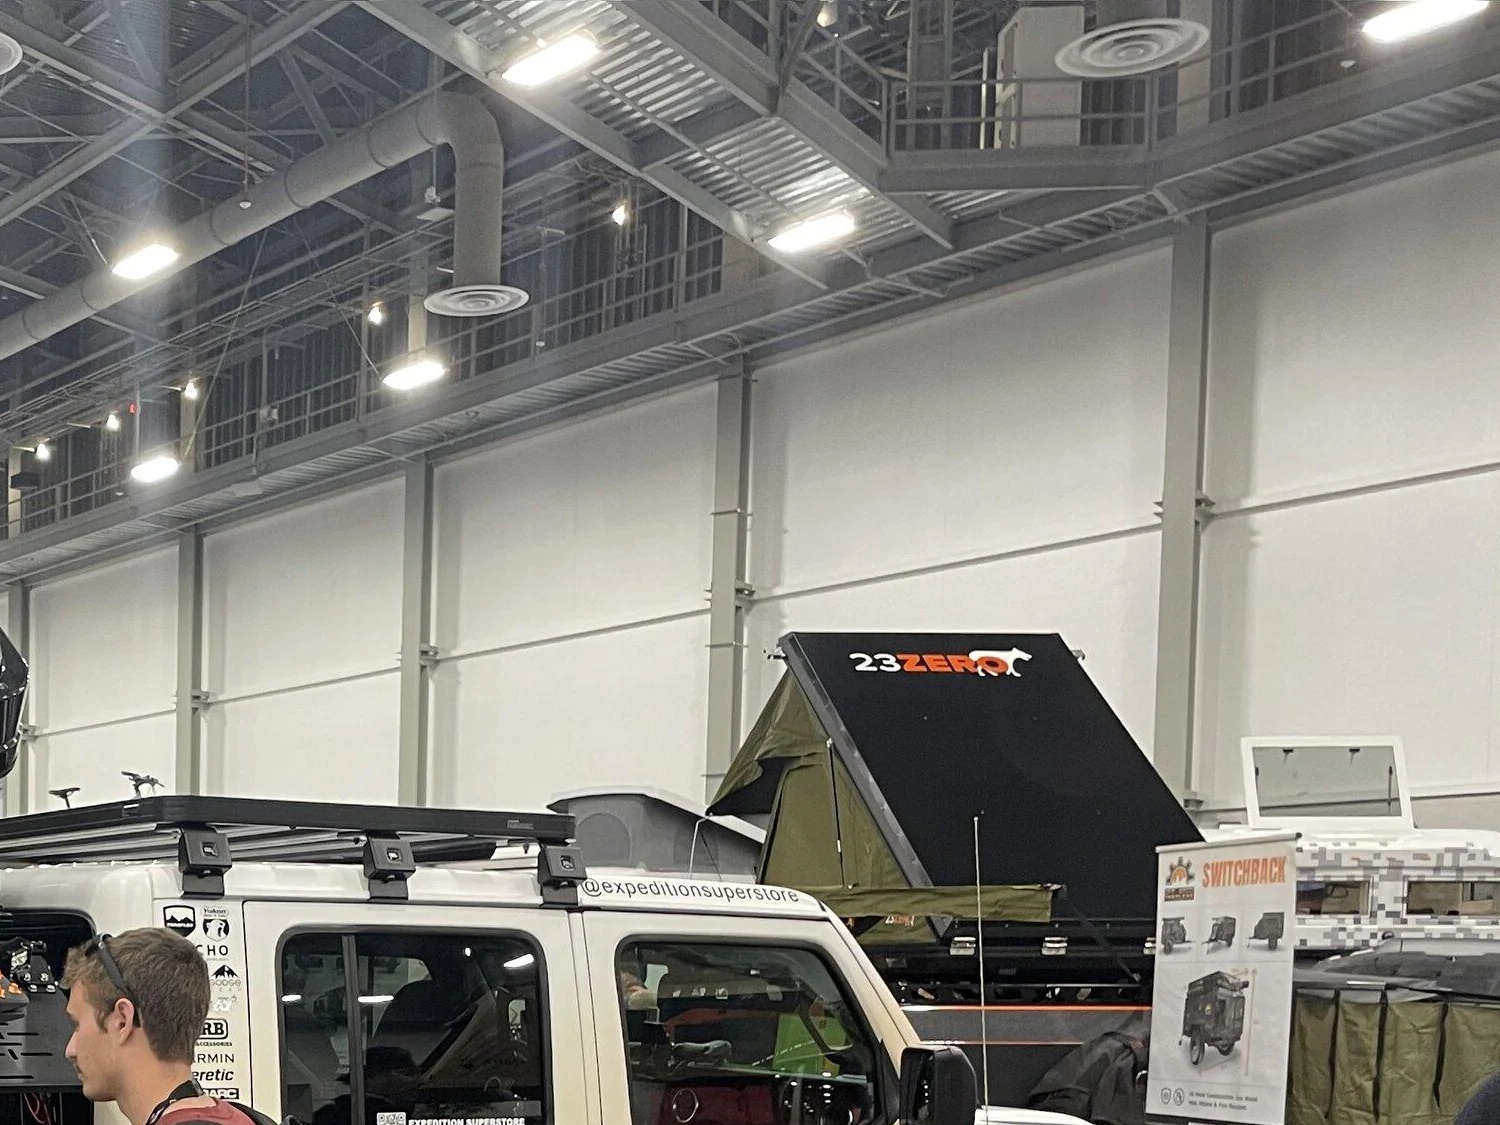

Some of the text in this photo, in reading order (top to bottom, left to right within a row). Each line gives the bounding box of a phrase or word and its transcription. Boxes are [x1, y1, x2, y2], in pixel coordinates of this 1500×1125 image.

[850, 653, 1009, 674] 23ZERO
[1202, 856, 1286, 888] SWITCHBACK
[581, 878, 799, 903] @expeditionsuperstore
